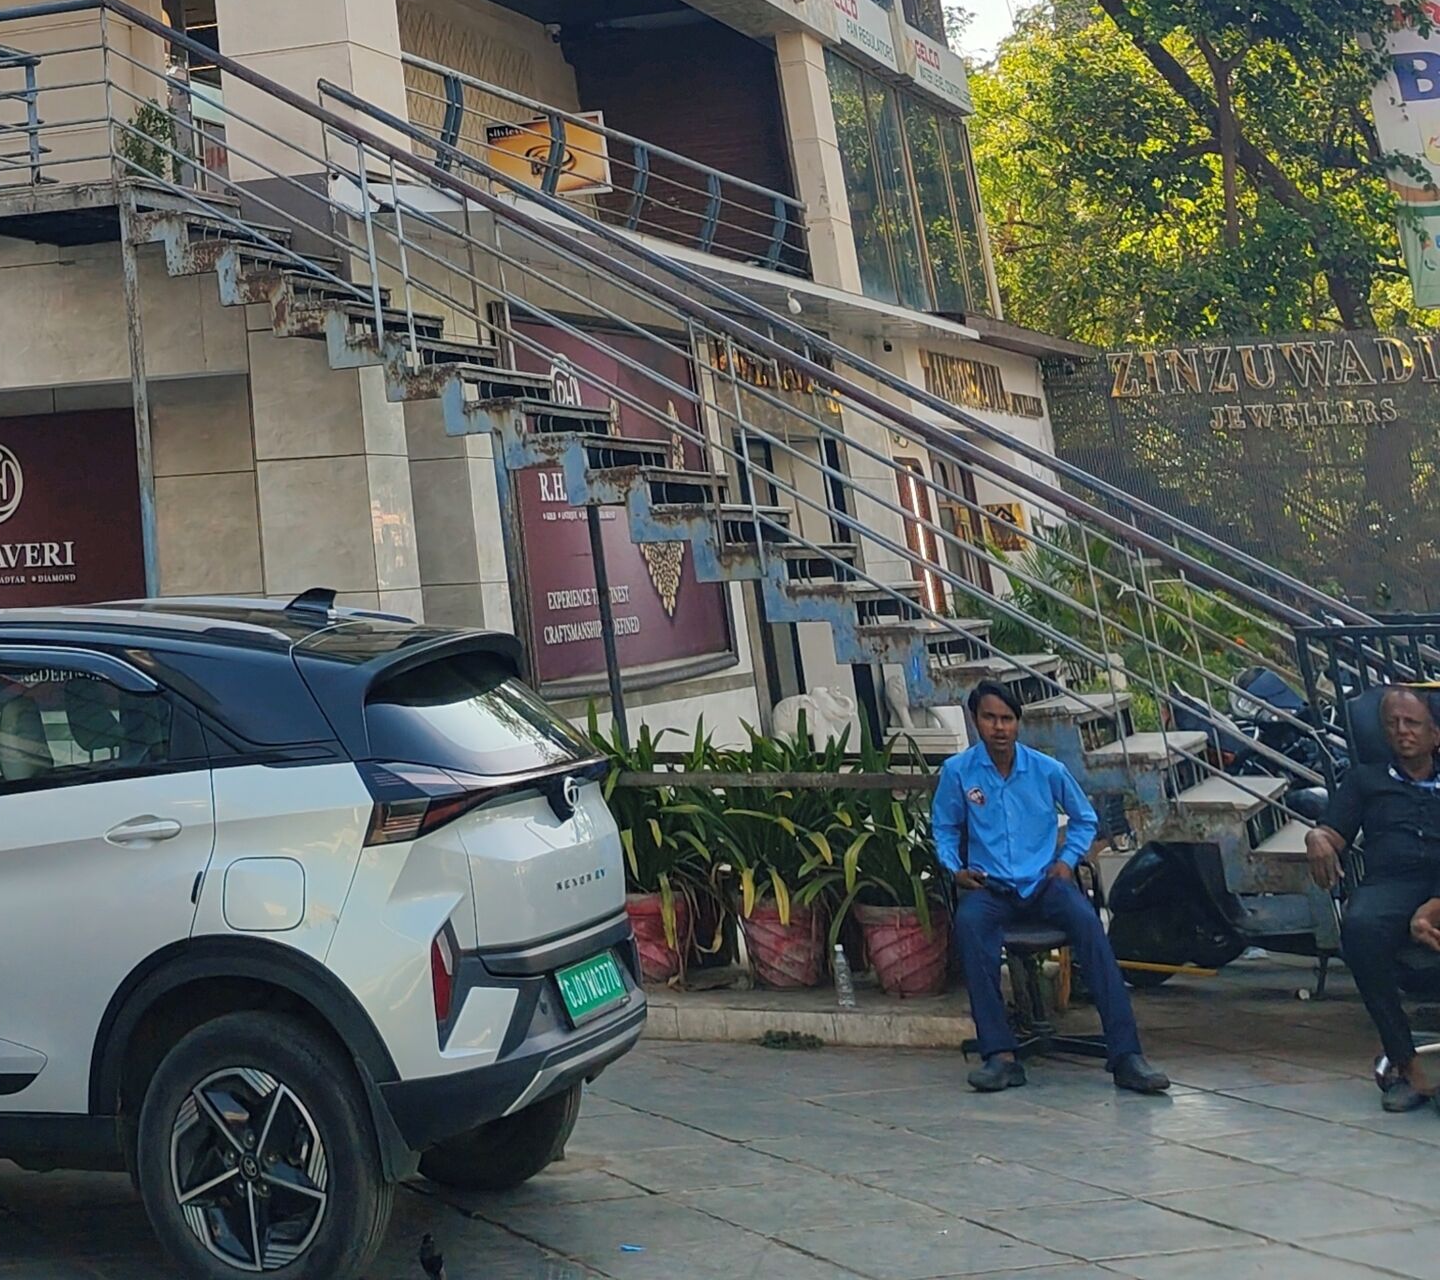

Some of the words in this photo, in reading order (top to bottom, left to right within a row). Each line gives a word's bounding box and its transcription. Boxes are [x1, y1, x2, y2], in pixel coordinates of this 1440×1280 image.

[1210, 399, 1399, 430] JEWELLERS
[547, 589, 592, 610] EXPERIENCE
[544, 619, 602, 645] CRAFTSMANSHIP
